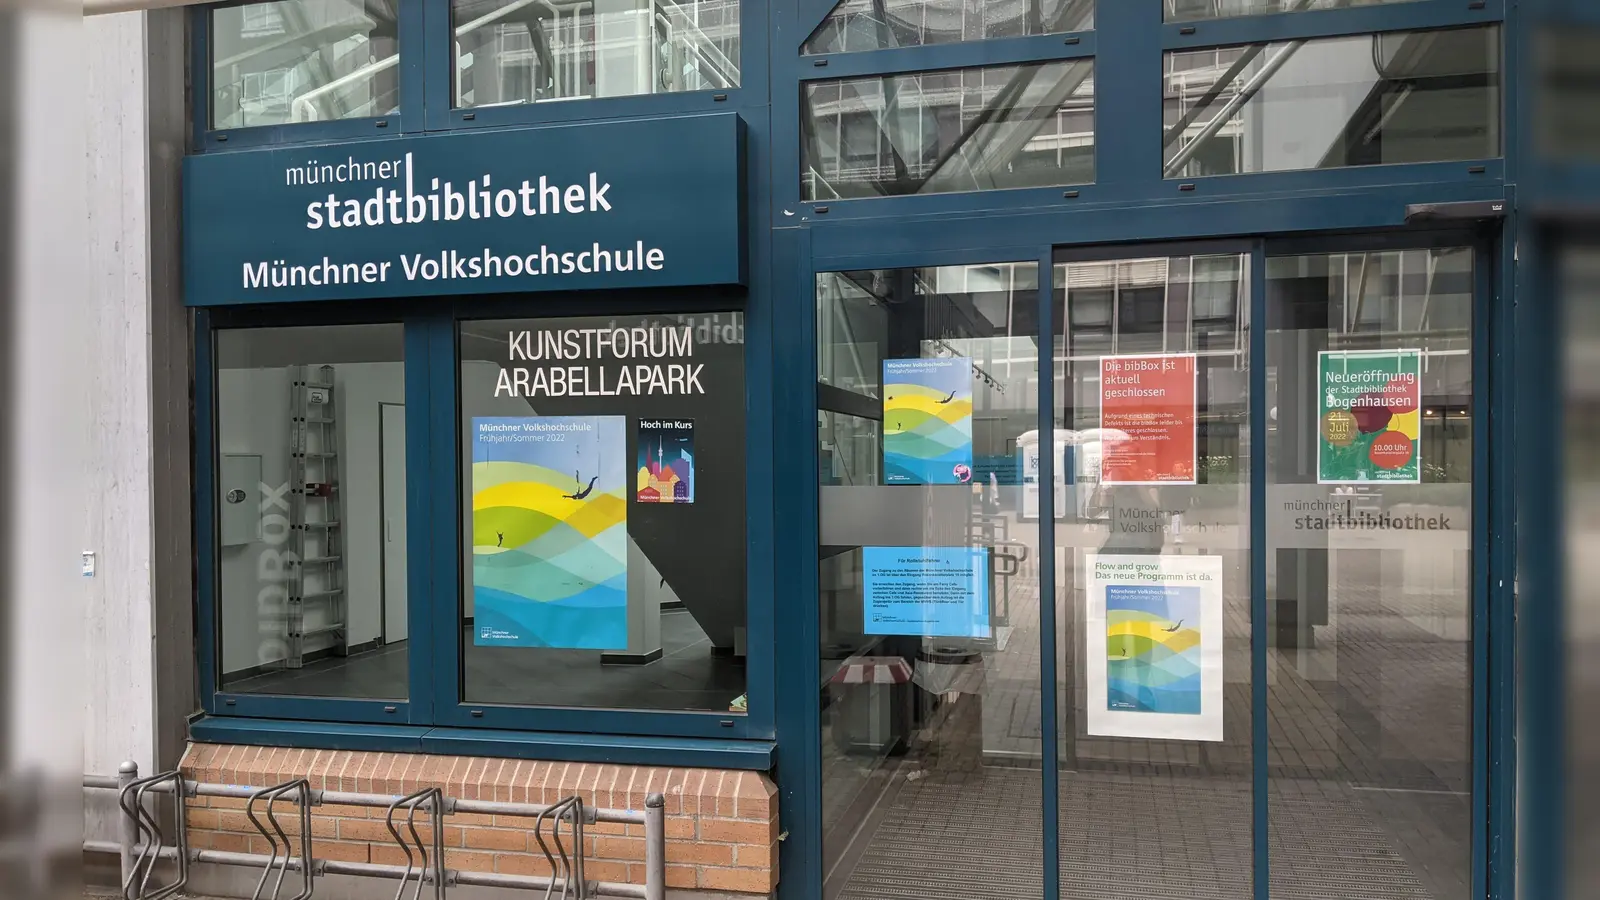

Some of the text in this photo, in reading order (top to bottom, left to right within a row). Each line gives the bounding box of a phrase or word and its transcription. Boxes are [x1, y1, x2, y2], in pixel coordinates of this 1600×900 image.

[285, 158, 401, 186] münchner
[306, 152, 612, 230] stadtbibliothek
[242, 240, 665, 289] Münchner Volkshochschule
[508, 326, 693, 361] KUNSTFORUM
[1105, 360, 1176, 371] Die bibBox ist
[494, 363, 705, 398] ARABELLAPARK
[1105, 374, 1141, 385] aktuell
[1325, 370, 1415, 385] Neueröffnung
[1104, 388, 1166, 400] geschlossen
[1325, 384, 1407, 394] der Stadtbibliothek
[1325, 395, 1411, 410] Bogenhausen
[479, 423, 592, 432] Münchner Volkshochschule
[640, 420, 693, 429] Hoch im Kurs
[1329, 422, 1349, 433] Juli
[479, 434, 565, 443] Frühjahr/Sommer 2022
[1283, 499, 1346, 511] münchner
[1119, 508, 1186, 519] Münchner
[1294, 500, 1451, 530] stadtbibliothek
[1095, 562, 1159, 573] Flow and grow
[1095, 572, 1111, 580] Das
[1137, 572, 1184, 582] Programm
[1186, 573, 1197, 581] ist
[1199, 573, 1213, 581] da.
